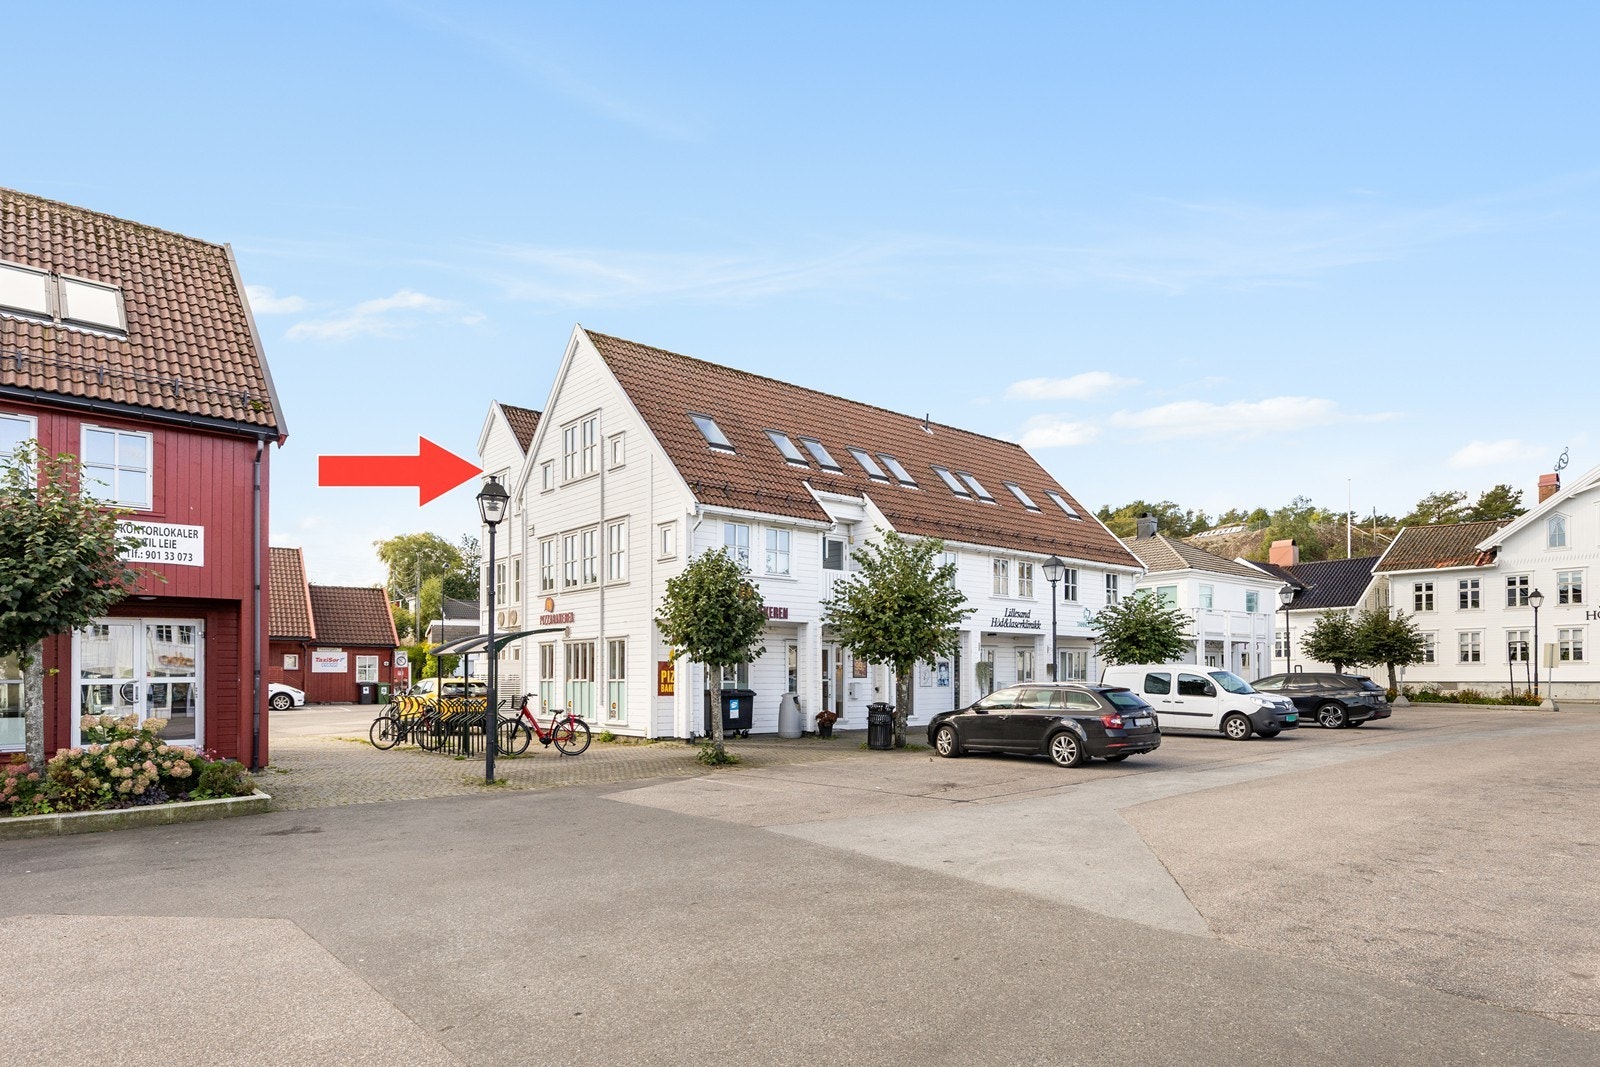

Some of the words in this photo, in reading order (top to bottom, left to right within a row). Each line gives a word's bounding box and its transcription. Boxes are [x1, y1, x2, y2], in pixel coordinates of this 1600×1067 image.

[120, 522, 199, 539] KONTORLOKALER
[158, 538, 177, 549] LEIE
[145, 550, 161, 560] 901
[164, 551, 175, 561] 33
[177, 552, 193, 562] 073
[1004, 607, 1031, 619] Lillesand
[660, 684, 674, 693] BAK
